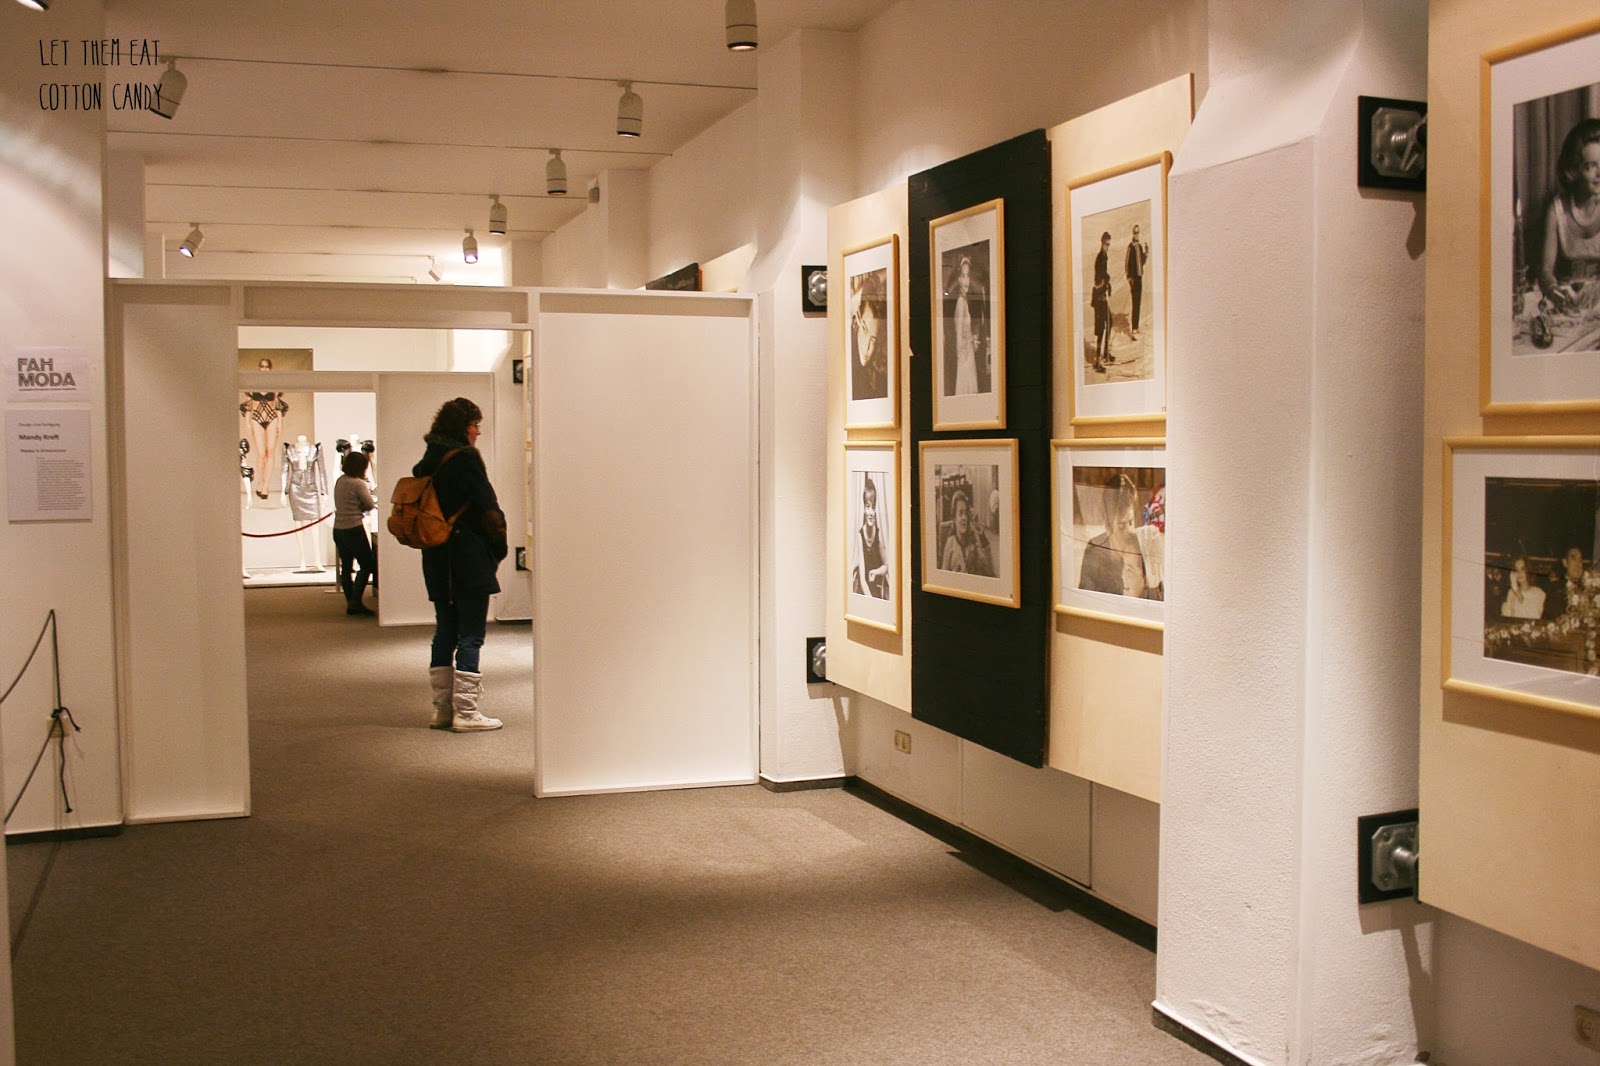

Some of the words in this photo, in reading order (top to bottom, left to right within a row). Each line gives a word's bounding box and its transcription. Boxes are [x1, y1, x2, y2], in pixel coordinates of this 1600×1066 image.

[18, 358, 54, 372] FAH
[18, 372, 76, 387] MODA
[18, 434, 42, 442] Mandy
